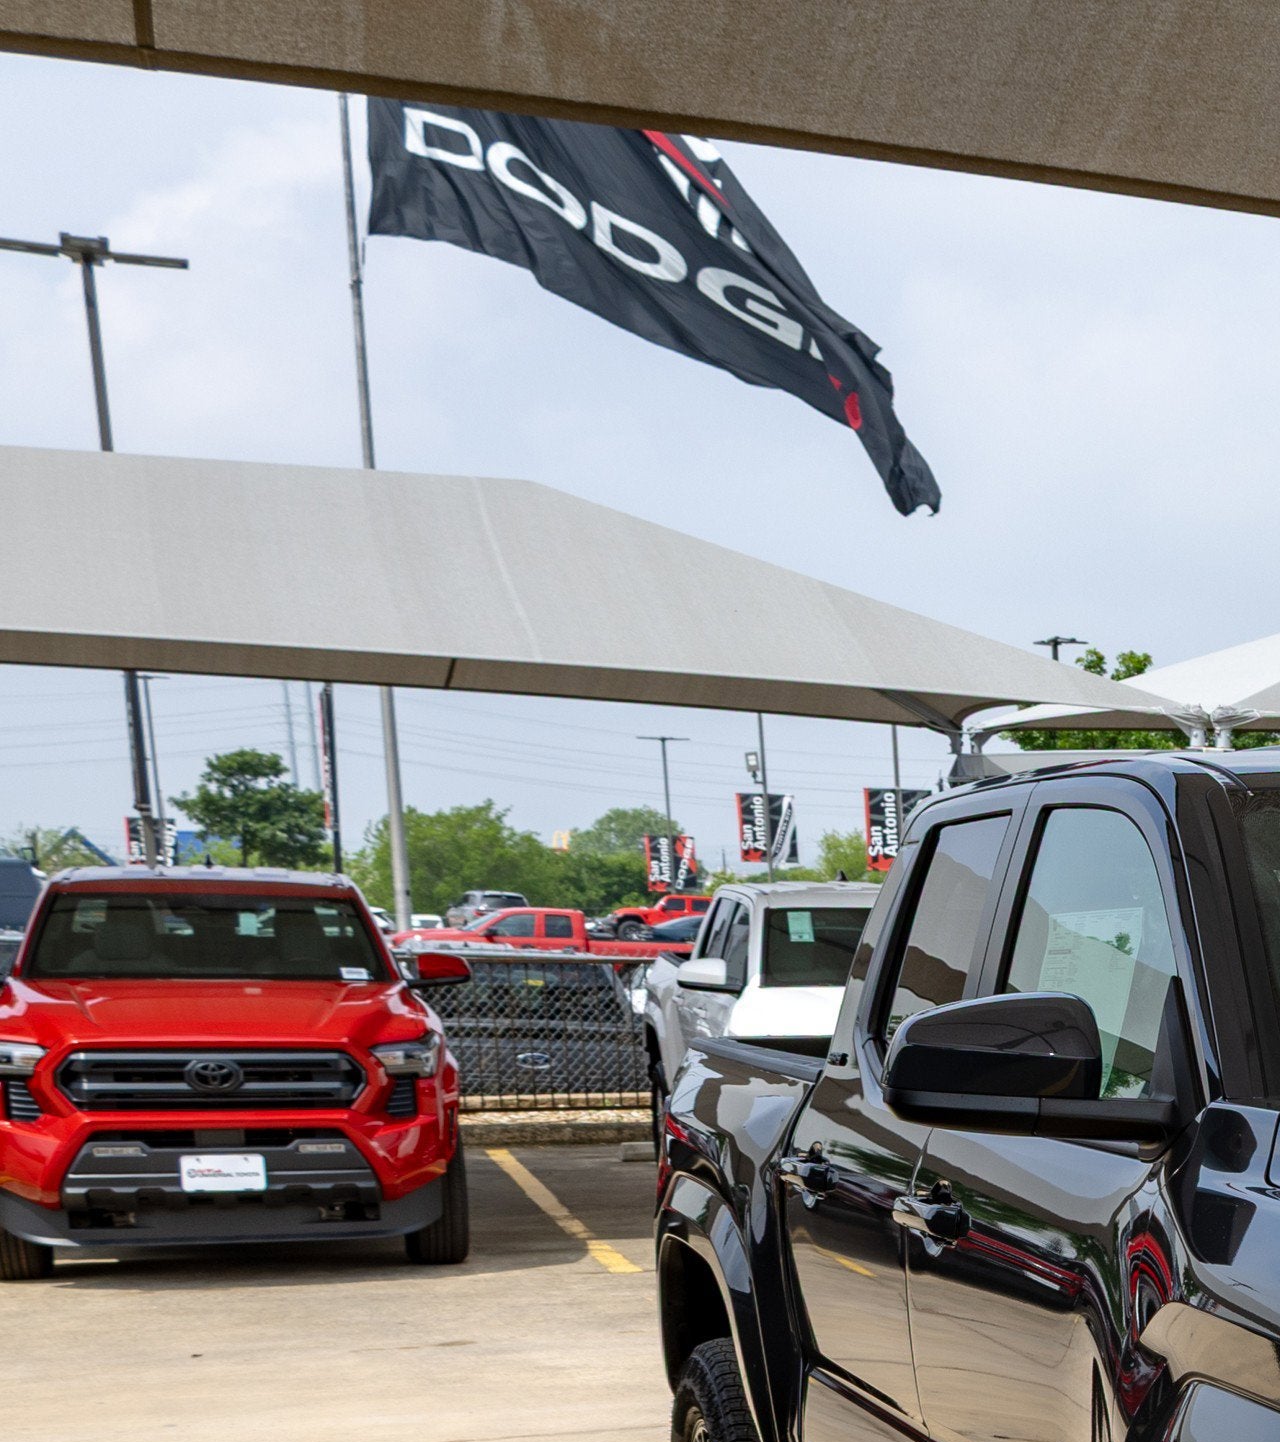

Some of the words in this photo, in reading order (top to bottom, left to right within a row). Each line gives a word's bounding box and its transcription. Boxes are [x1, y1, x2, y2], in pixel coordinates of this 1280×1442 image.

[403, 106, 823, 361] DODG
[741, 824, 754, 850] San
[750, 796, 767, 851] Antonio
[868, 825, 884, 857] San
[881, 792, 899, 857] Antonio
[649, 860, 660, 882] San
[657, 837, 672, 883] Antonio
